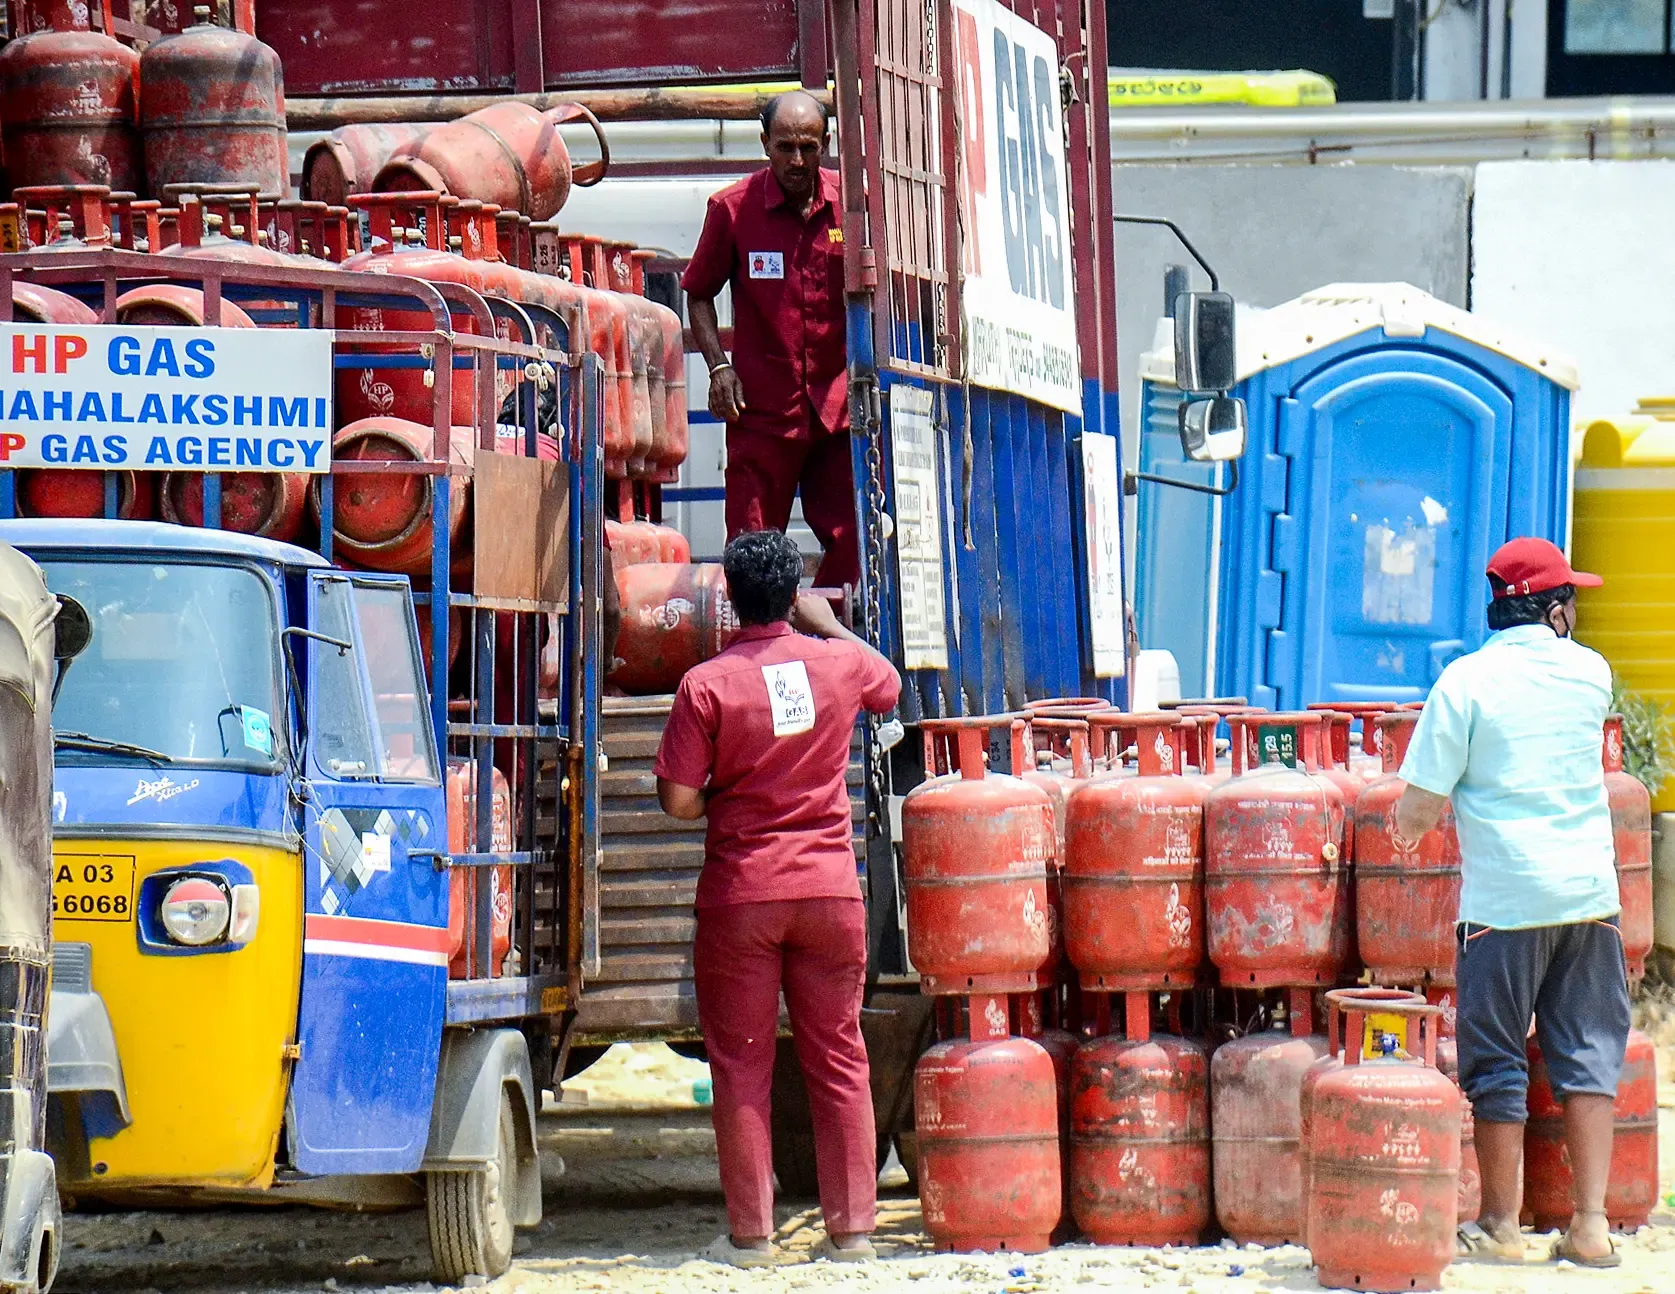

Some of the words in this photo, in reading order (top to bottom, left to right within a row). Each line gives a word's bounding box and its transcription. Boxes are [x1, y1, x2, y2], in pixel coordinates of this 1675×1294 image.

[994, 26, 1064, 312] GAS
[12, 334, 88, 374] HP
[107, 336, 216, 378] GAS
[0, 390, 326, 428] AHALAKSHMI
[41, 434, 128, 464] GAS
[144, 436, 324, 468] AGENCY
[83, 864, 114, 883] 03
